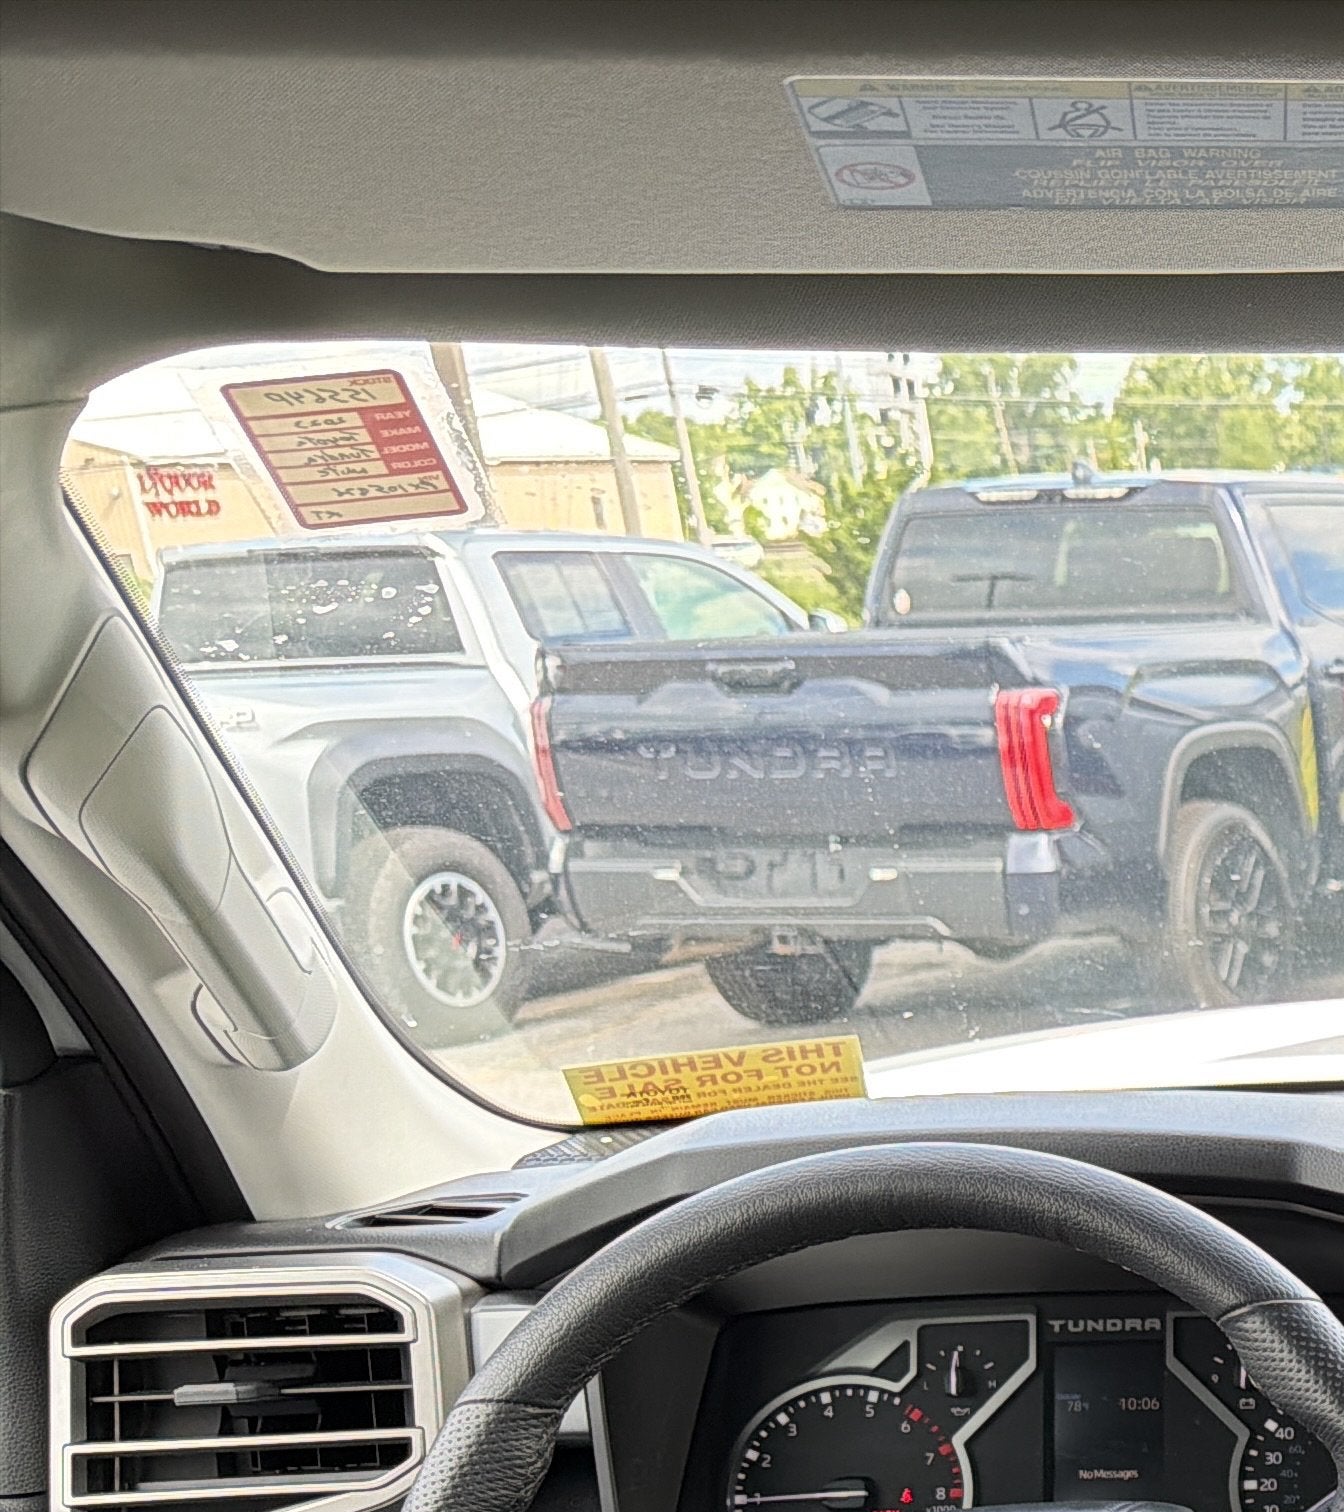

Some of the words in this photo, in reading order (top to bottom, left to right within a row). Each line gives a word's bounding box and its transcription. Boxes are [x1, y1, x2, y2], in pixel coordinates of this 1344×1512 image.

[1095, 148, 1122, 158] AIR
[1134, 148, 1170, 158] BAG
[1183, 149, 1261, 159] WARNING
[1222, 159, 1284, 167] OVER
[1014, 169, 1091, 179] COUSSIN
[1097, 169, 1198, 179] GONFLABLE
[1205, 169, 1338, 179] AVERTISSEMENT
[1022, 188, 1137, 199] ADVERTENCIA
[1143, 189, 1178, 199] CON
[1185, 188, 1205, 199] LA
[1212, 188, 1269, 199] BOLSA
[1273, 188, 1296, 198] DE
[1300, 187, 1338, 198] AIRE
[143, 500, 220, 518] WORLD
[637, 739, 898, 780] TUNDRA
[1049, 1318, 1162, 1334] TUNDRA
[1120, 1397, 1160, 1411] 10:06
[823, 1405, 835, 1418] 4
[864, 1405, 876, 1418] 5
[788, 1424, 798, 1437] 3
[901, 1421, 912, 1434] 6
[1275, 1427, 1295, 1440] 40
[761, 1455, 773, 1469] 2
[925, 1453, 935, 1466] 7
[1264, 1451, 1283, 1465] 30
[1079, 1469, 1094, 1479] No
[1094, 1469, 1139, 1481] Messages
[1260, 1478, 1278, 1492] 20
[935, 1487, 947, 1501] 8
